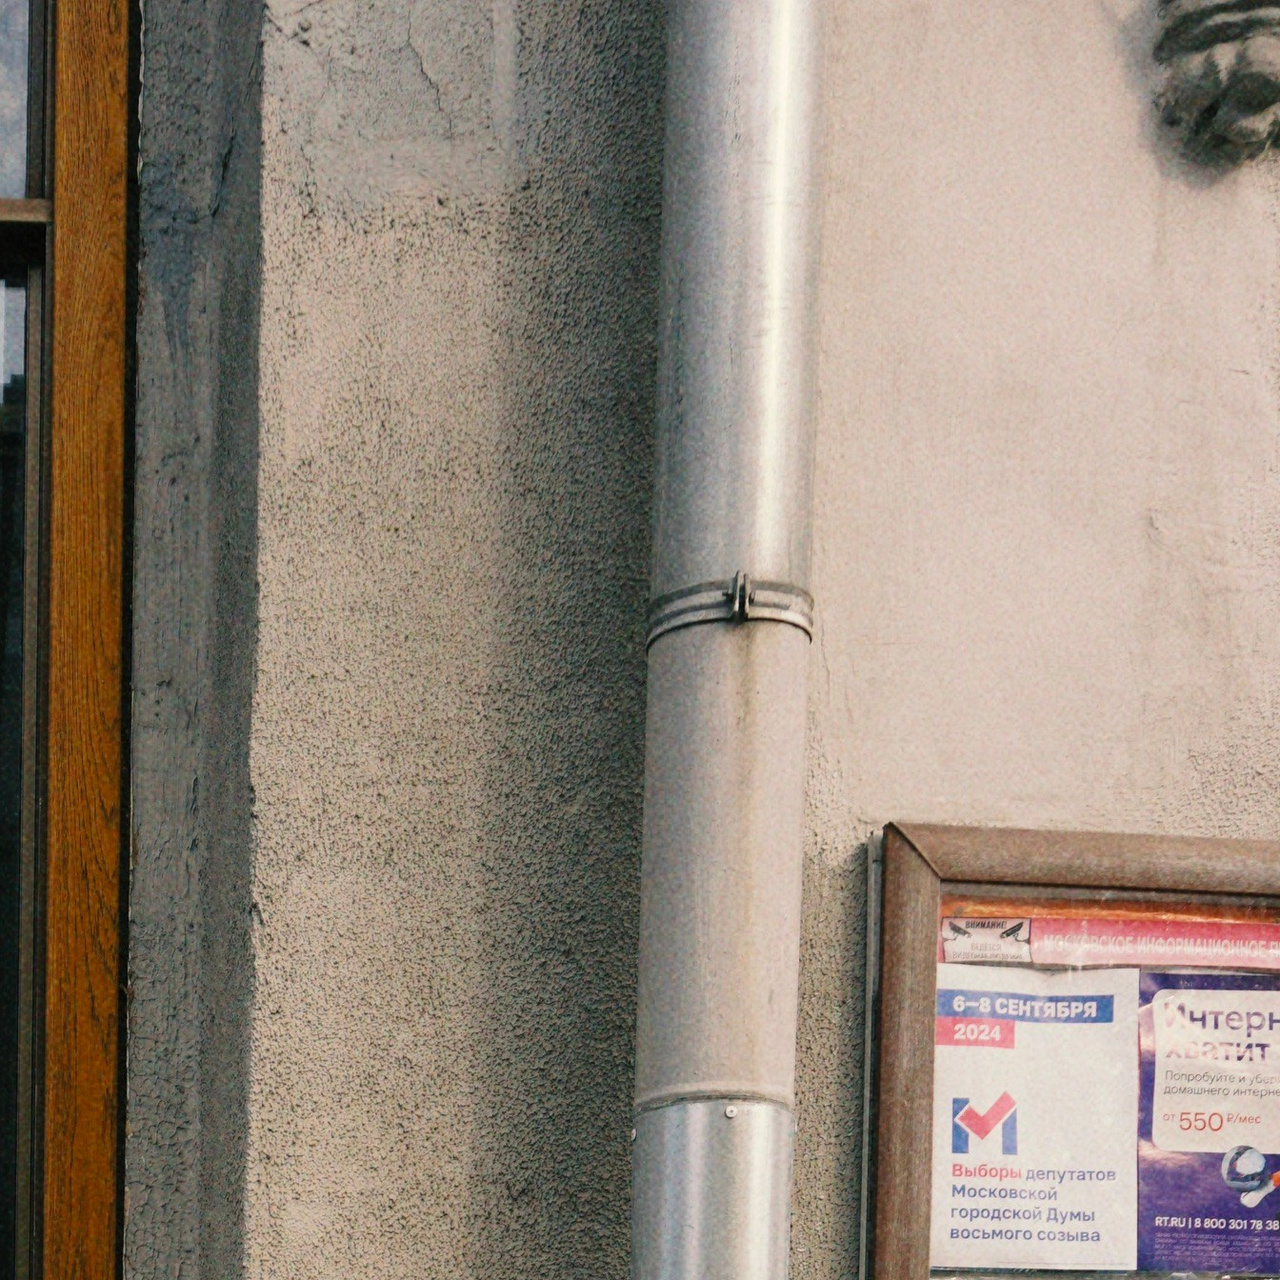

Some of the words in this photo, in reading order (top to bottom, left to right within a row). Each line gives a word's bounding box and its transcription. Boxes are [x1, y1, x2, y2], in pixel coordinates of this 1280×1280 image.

[1043, 935, 1134, 954] МОСКОВСКОЕ
[1137, 937, 1266, 958] ИНФОРМАЦИОННОЕ
[995, 998, 1098, 1018] СЕНТЯБРЯ
[953, 1023, 1001, 1041] 2024
[1165, 1069, 1236, 1085] Попробуйте
[1238, 1075, 1246, 1083] и
[1163, 1085, 1230, 1097] домашнего
[1163, 1113, 1176, 1122] от
[1179, 1111, 1224, 1132] 550
[952, 1163, 1021, 1181] Выборы
[1025, 1168, 1116, 1184] депутатов
[951, 1184, 1058, 1200] Московской
[950, 1206, 1042, 1222] городской
[1046, 1207, 1095, 1225] Думы
[1155, 1216, 1186, 1227] RT.RU
[1194, 1217, 1202, 1228] 8
[1203, 1218, 1226, 1229] 800
[1228, 1219, 1248, 1230] 301
[1250, 1219, 1263, 1230] 78
[1265, 1219, 1280, 1231] 38
[950, 1228, 1033, 1241] восьмого
[1037, 1230, 1101, 1242] созыва
